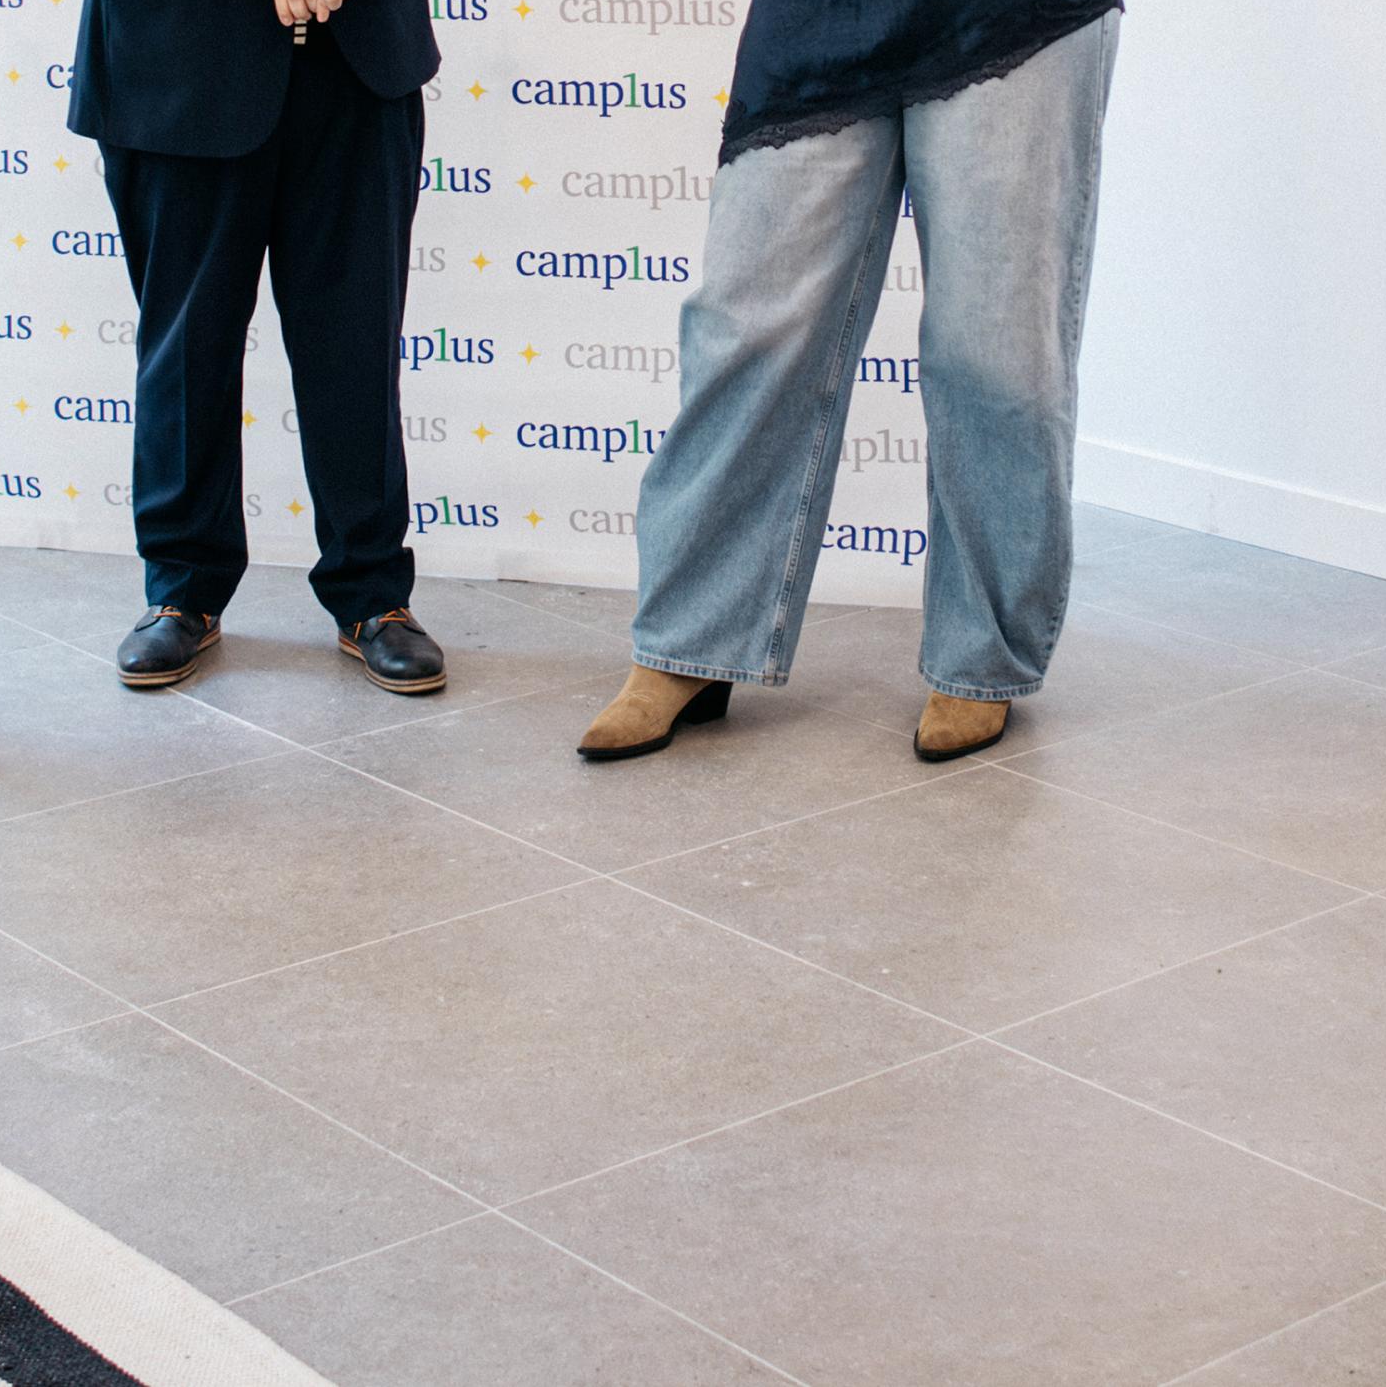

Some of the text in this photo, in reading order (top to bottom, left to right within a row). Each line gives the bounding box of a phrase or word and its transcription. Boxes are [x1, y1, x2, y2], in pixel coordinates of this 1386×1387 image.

[511, 72, 687, 118] camplus
[562, 165, 713, 211] camplu
[516, 245, 690, 291] camplus
[400, 327, 495, 371] plus
[564, 341, 676, 383] camp
[412, 495, 500, 534] plus
